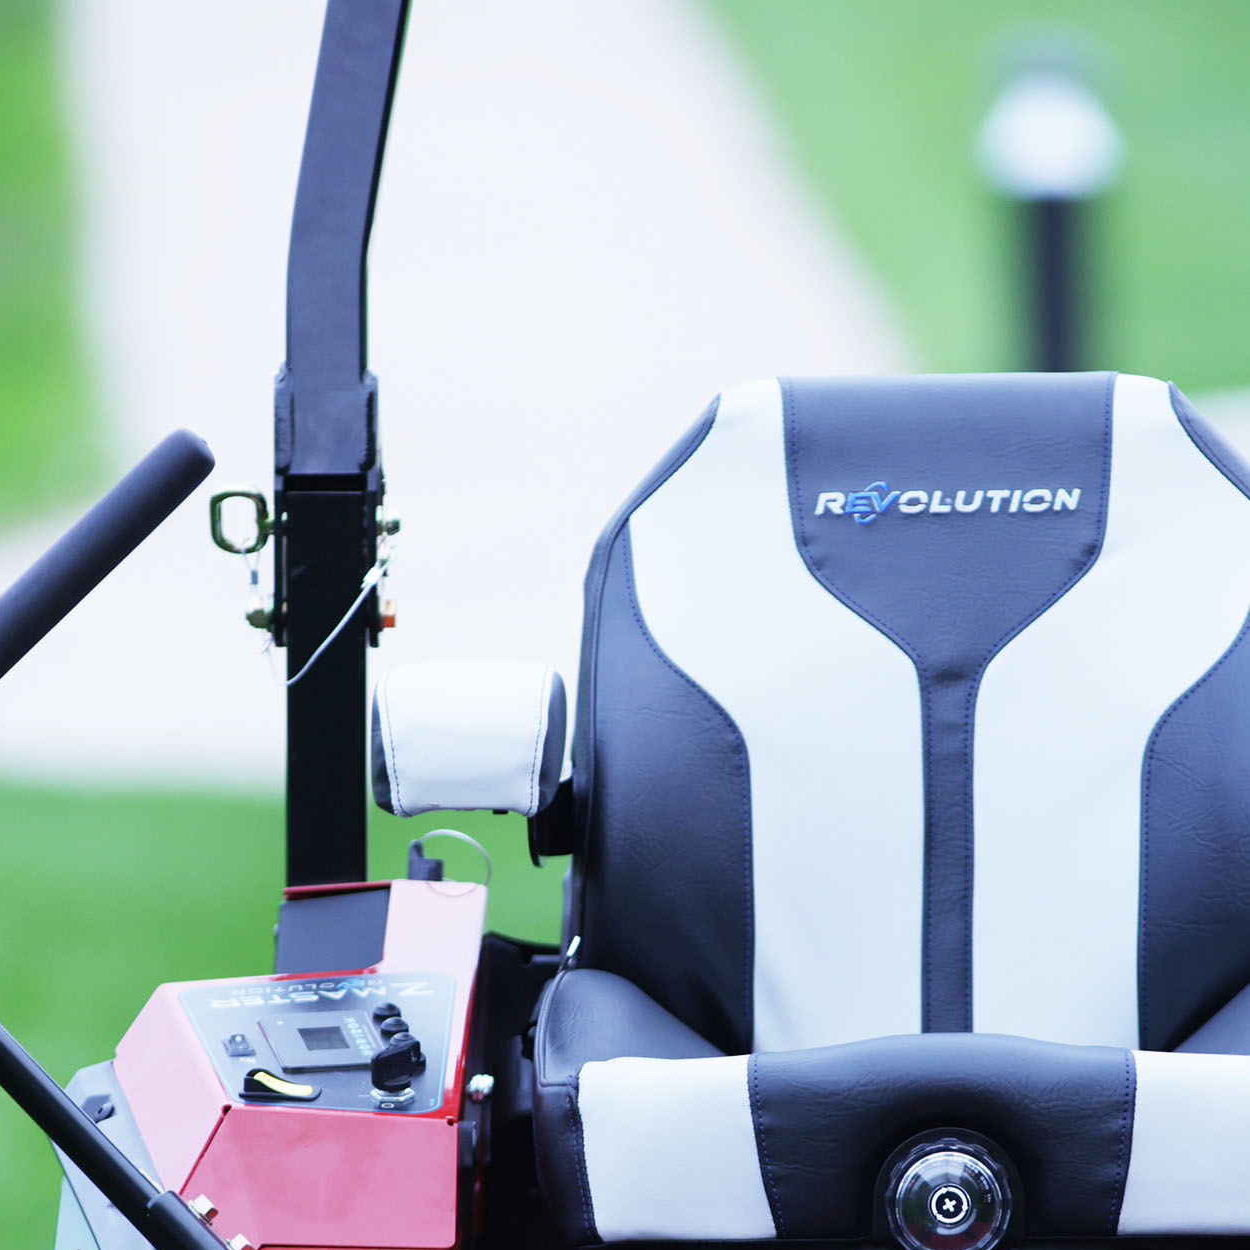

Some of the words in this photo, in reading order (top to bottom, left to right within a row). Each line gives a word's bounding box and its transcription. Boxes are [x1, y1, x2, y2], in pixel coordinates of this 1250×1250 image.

[814, 484, 1081, 520] REVOLUTION
[210, 985, 387, 1008] MASTER
[391, 982, 434, 996] Z
